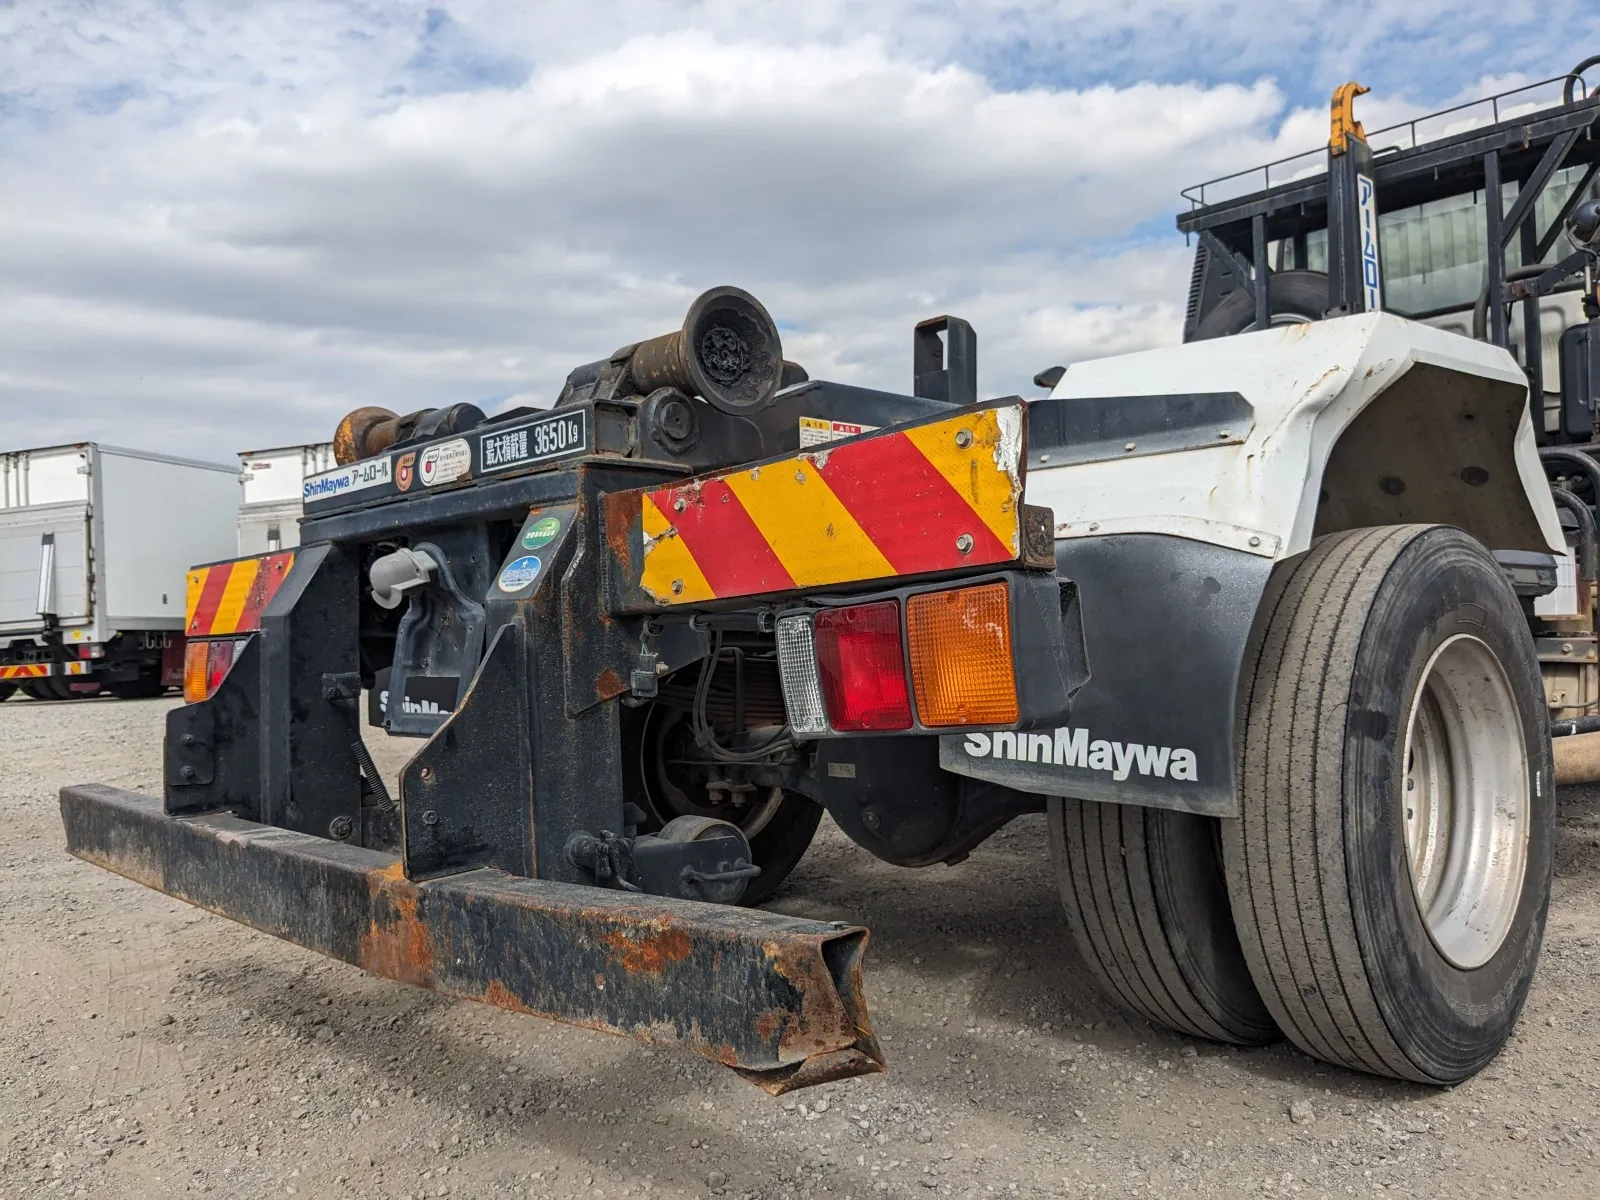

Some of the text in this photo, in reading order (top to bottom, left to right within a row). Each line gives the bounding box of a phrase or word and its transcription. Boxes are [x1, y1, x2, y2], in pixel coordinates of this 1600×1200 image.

[1359, 177, 1378, 311] アームロー
[486, 430, 528, 466] 最大積載量
[304, 462, 389, 498] ShinMaywa アームロール
